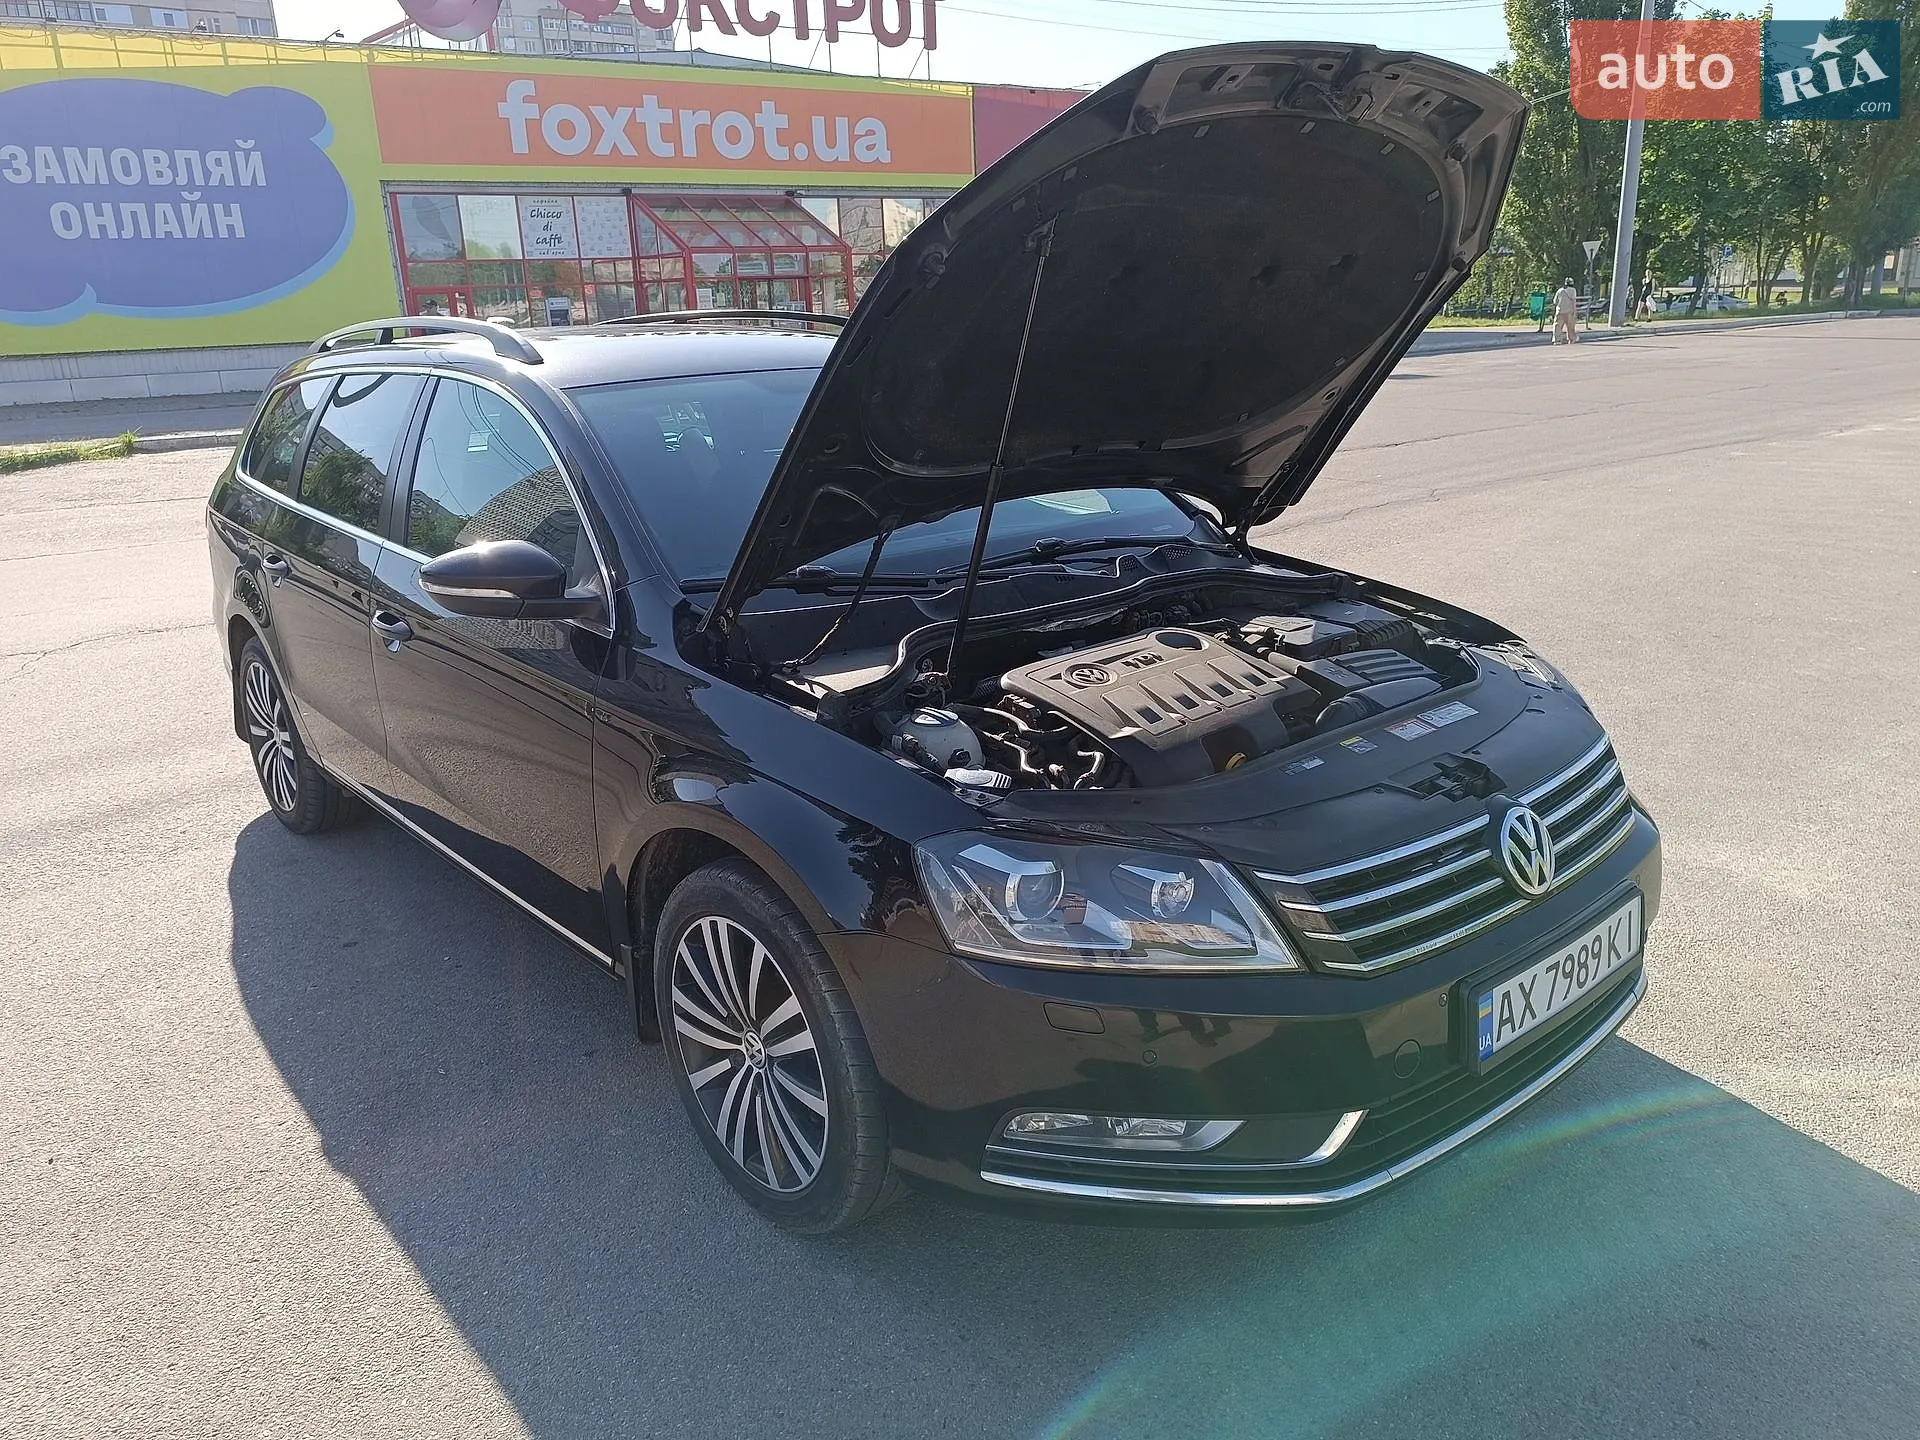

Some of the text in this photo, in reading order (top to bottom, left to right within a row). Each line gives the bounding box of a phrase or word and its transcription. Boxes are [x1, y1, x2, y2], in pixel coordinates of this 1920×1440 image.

[497, 79, 891, 164] foxtrot.ua
[1, 139, 267, 187] ЗАМОВЛЯЙ
[50, 191, 246, 240] ОНЛАЙН
[530, 207, 564, 219] Chicco
[542, 220, 553, 232] di
[1496, 910, 1633, 1043] AX 7989 KI
[1479, 1036, 1493, 1050] UA
